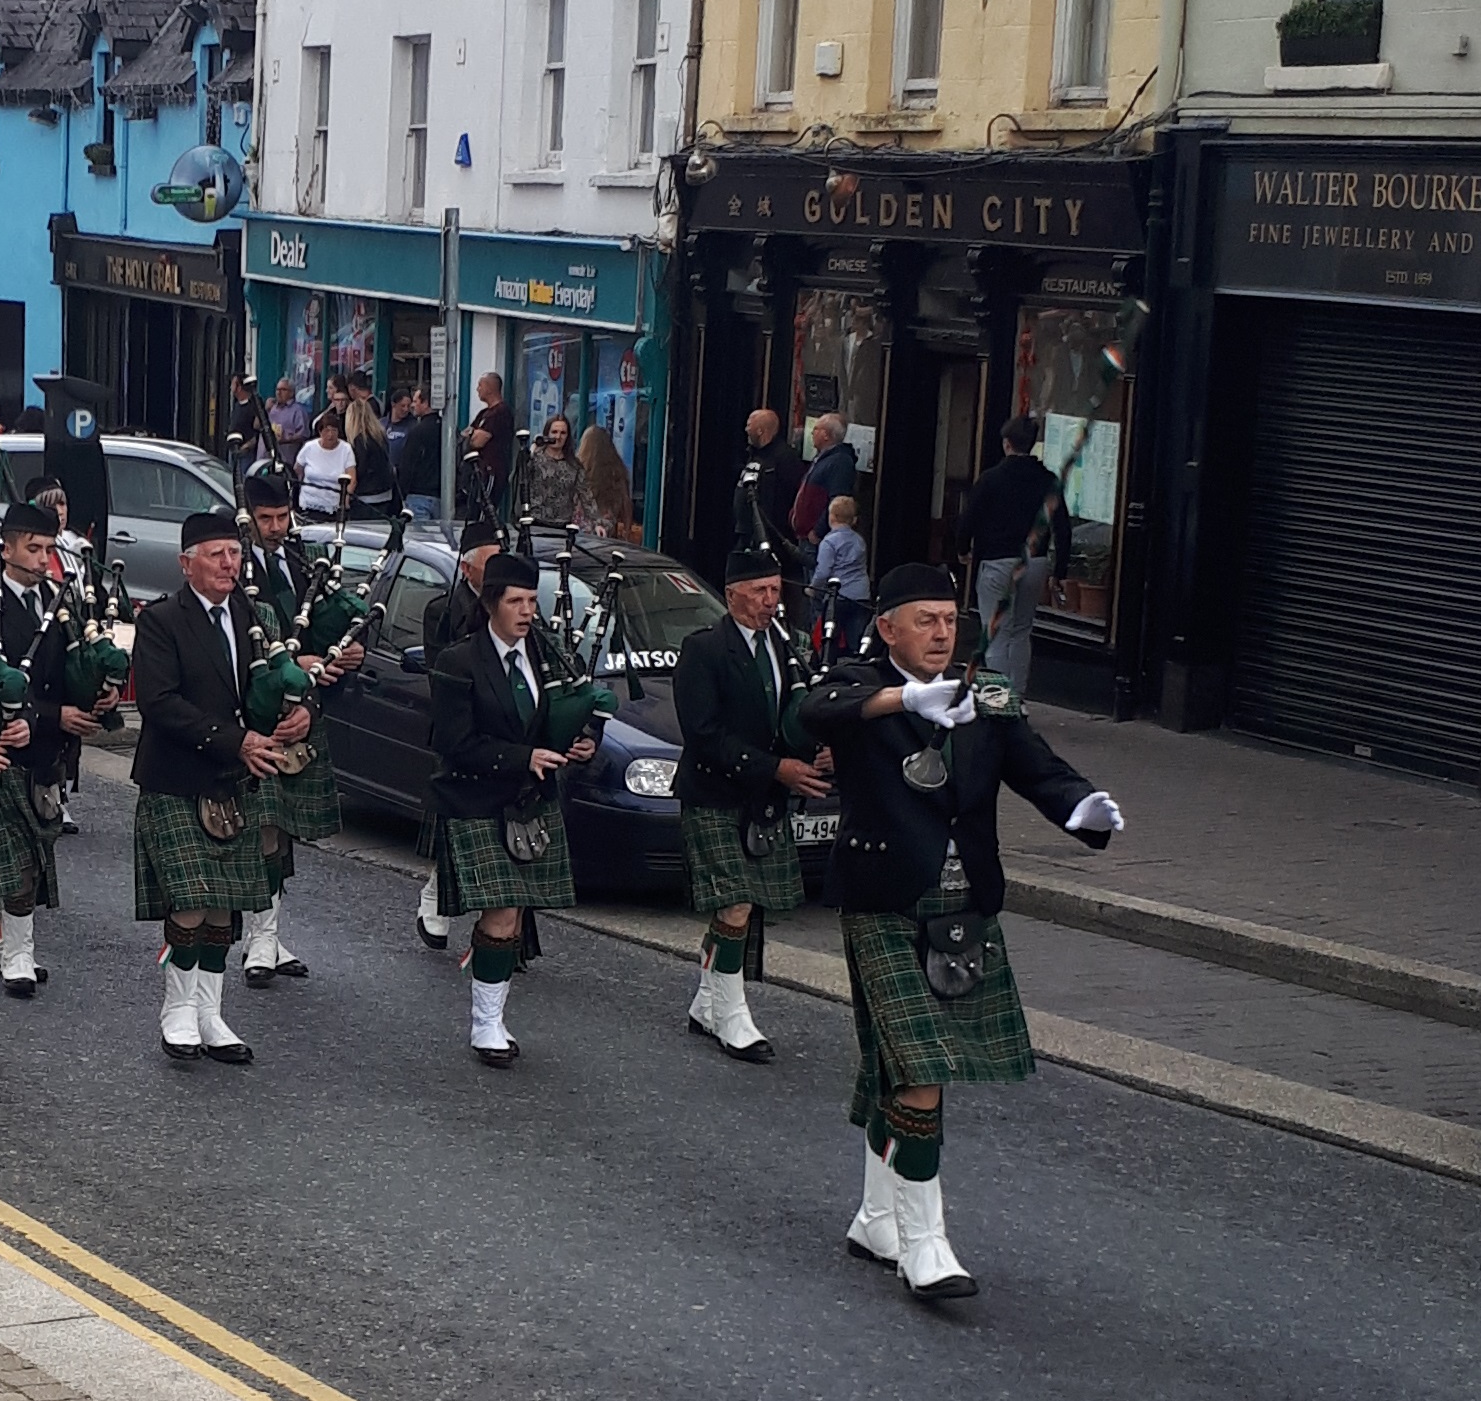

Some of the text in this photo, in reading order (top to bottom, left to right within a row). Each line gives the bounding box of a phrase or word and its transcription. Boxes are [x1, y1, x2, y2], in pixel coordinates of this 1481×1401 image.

[1254, 170, 1481, 212] WALTER BOURKE
[804, 189, 1085, 237] GOLDEN CITY
[270, 230, 306, 269] Dealz
[1248, 223, 1474, 254] FINE JEWELLERY AND
[106, 255, 182, 295] THE HOLY GRAIL
[828, 258, 868, 273] CHINESE
[494, 275, 528, 307] Amazing
[75, 409, 93, 439] P
[666, 573, 702, 593] N
